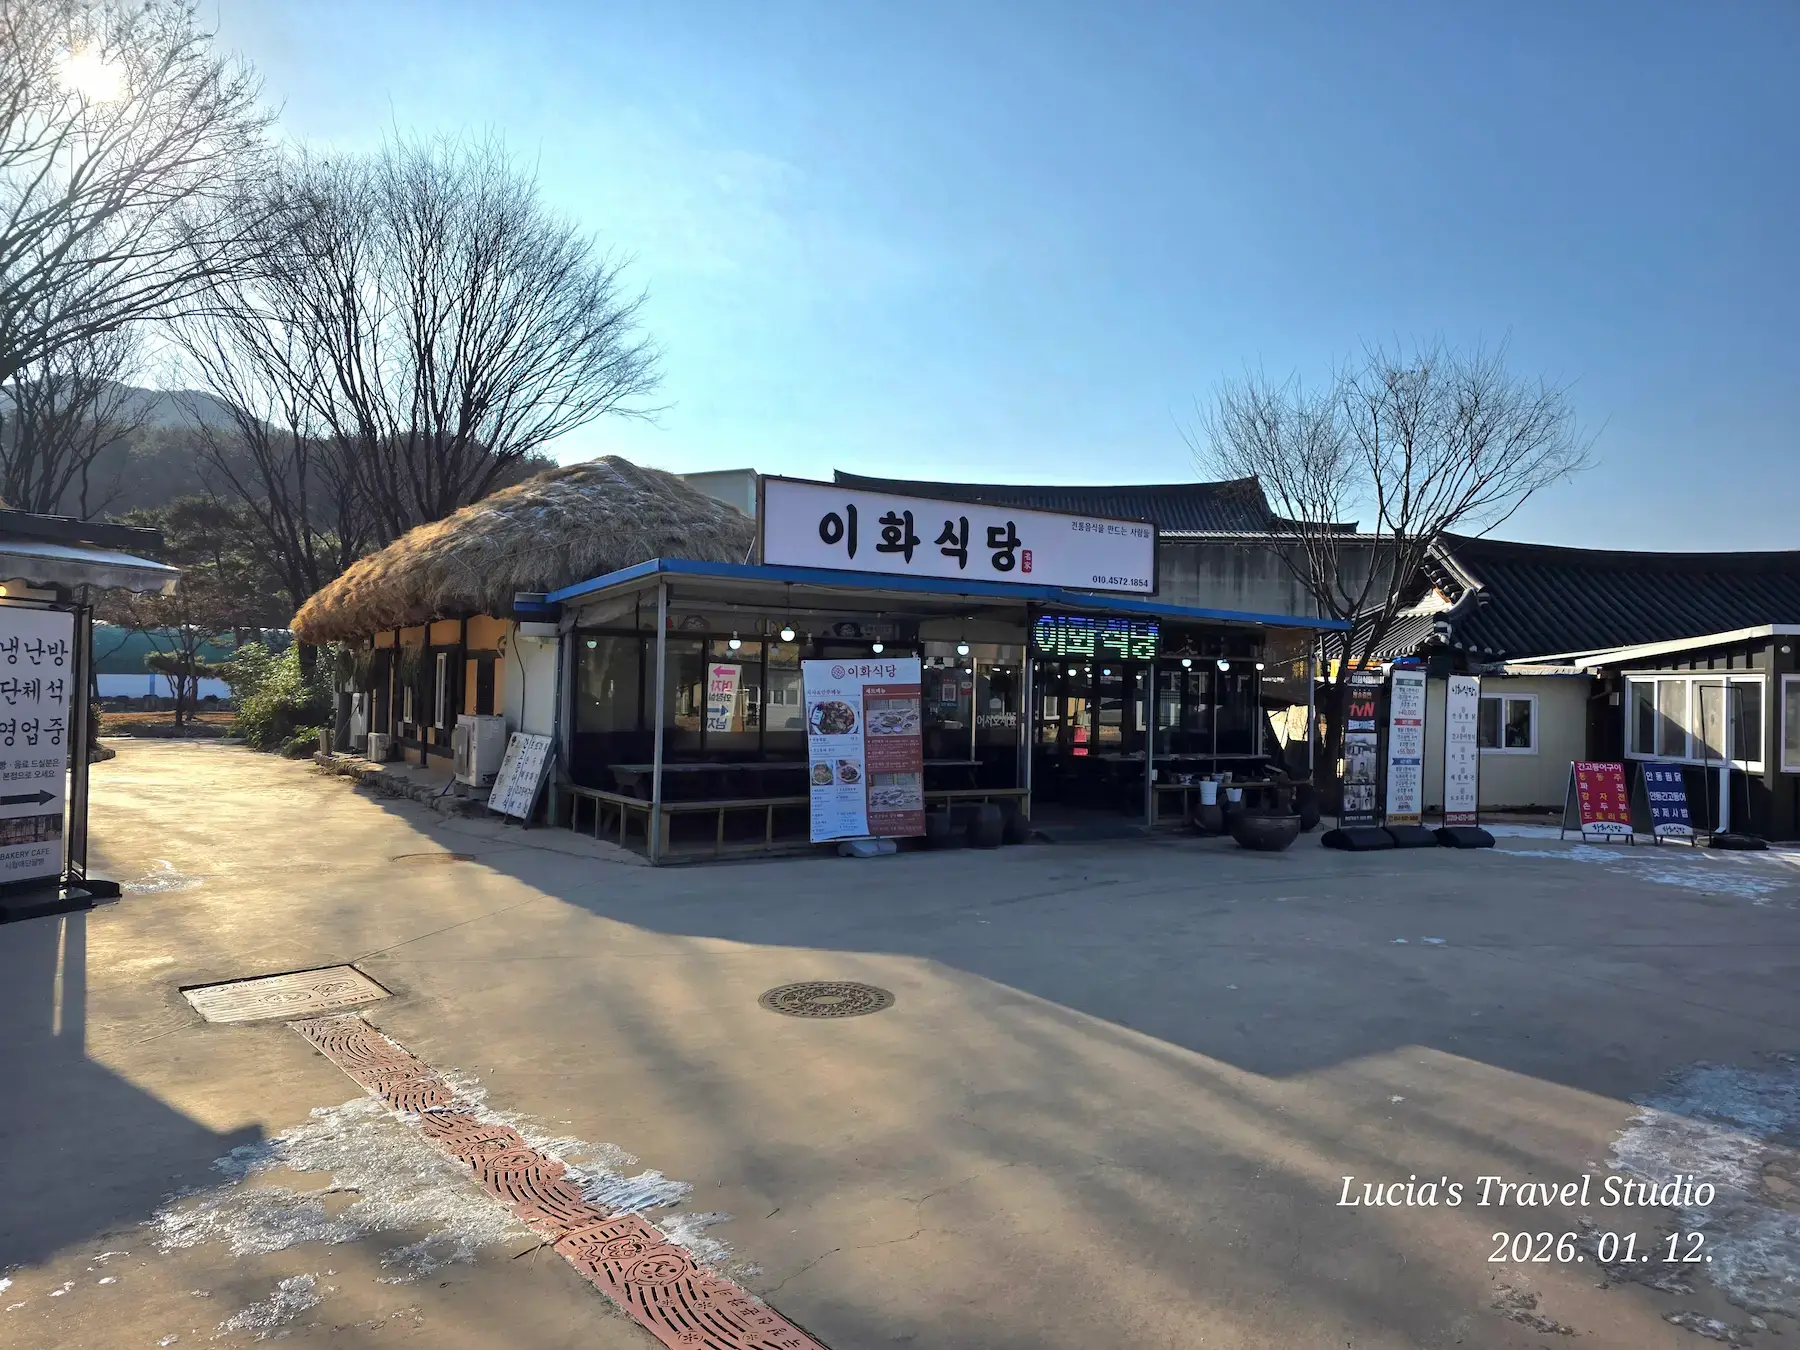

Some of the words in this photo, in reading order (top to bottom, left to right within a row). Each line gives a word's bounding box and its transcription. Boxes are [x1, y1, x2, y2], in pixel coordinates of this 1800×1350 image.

[819, 504, 1021, 572] 이화식당
[1107, 525, 1128, 536] 만드는
[1130, 528, 1150, 539] 사람들
[1092, 575, 1149, 587] 010.4572.1854
[0, 636, 69, 667] 냉난방
[848, 664, 897, 679] 이화식당
[0, 677, 64, 706] 단체석
[1349, 702, 1375, 717] tvN
[0, 718, 65, 746] 영업중
[34, 770, 55, 778] 오세요
[1578, 763, 1622, 772] 간고등어구이
[1650, 791, 1687, 802] 안동간고등어
[0, 850, 30, 861] BAKERY
[31, 848, 50, 857] CAFE
